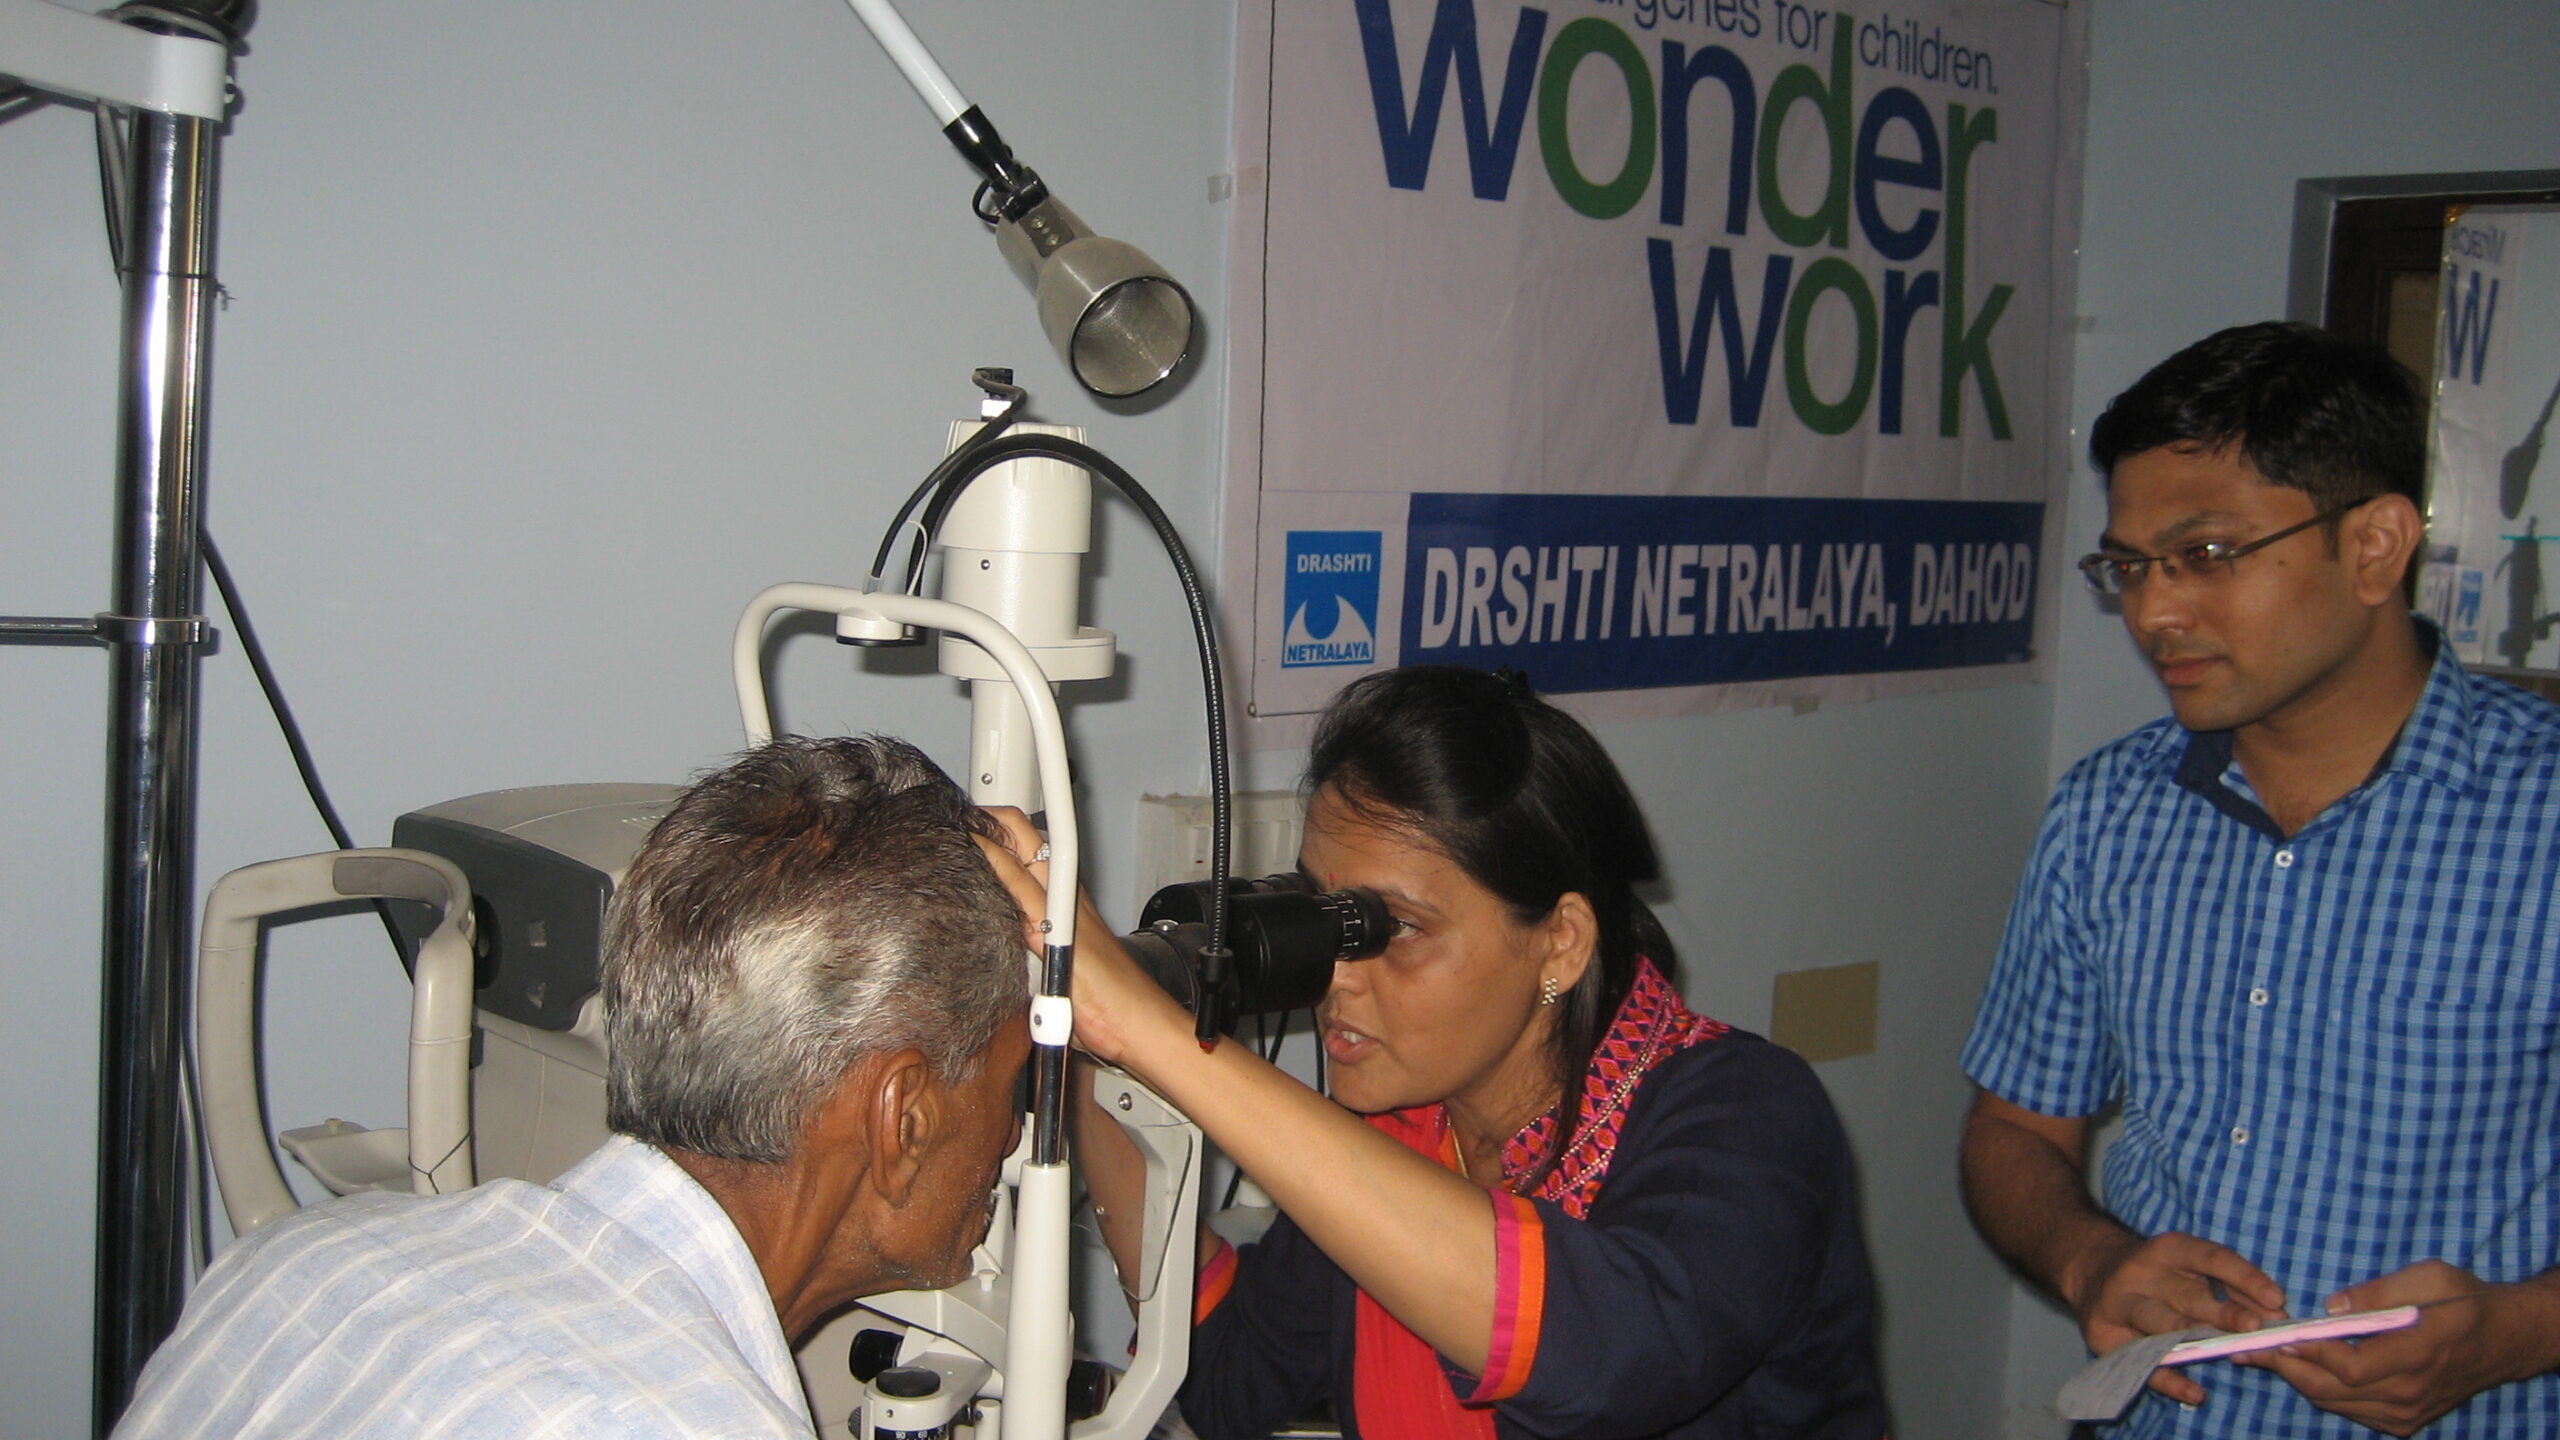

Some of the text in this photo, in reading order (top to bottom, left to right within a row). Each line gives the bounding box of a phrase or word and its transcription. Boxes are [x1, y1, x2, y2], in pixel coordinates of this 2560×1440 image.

[1774, 0, 1828, 52] for
[1859, 12, 1999, 95] children.
[1296, 553, 1372, 574] DRASHTI
[1419, 542, 2032, 649] DRSHTI NETRALAYA, DAHOD
[1286, 640, 1371, 662] NETRALAYA
